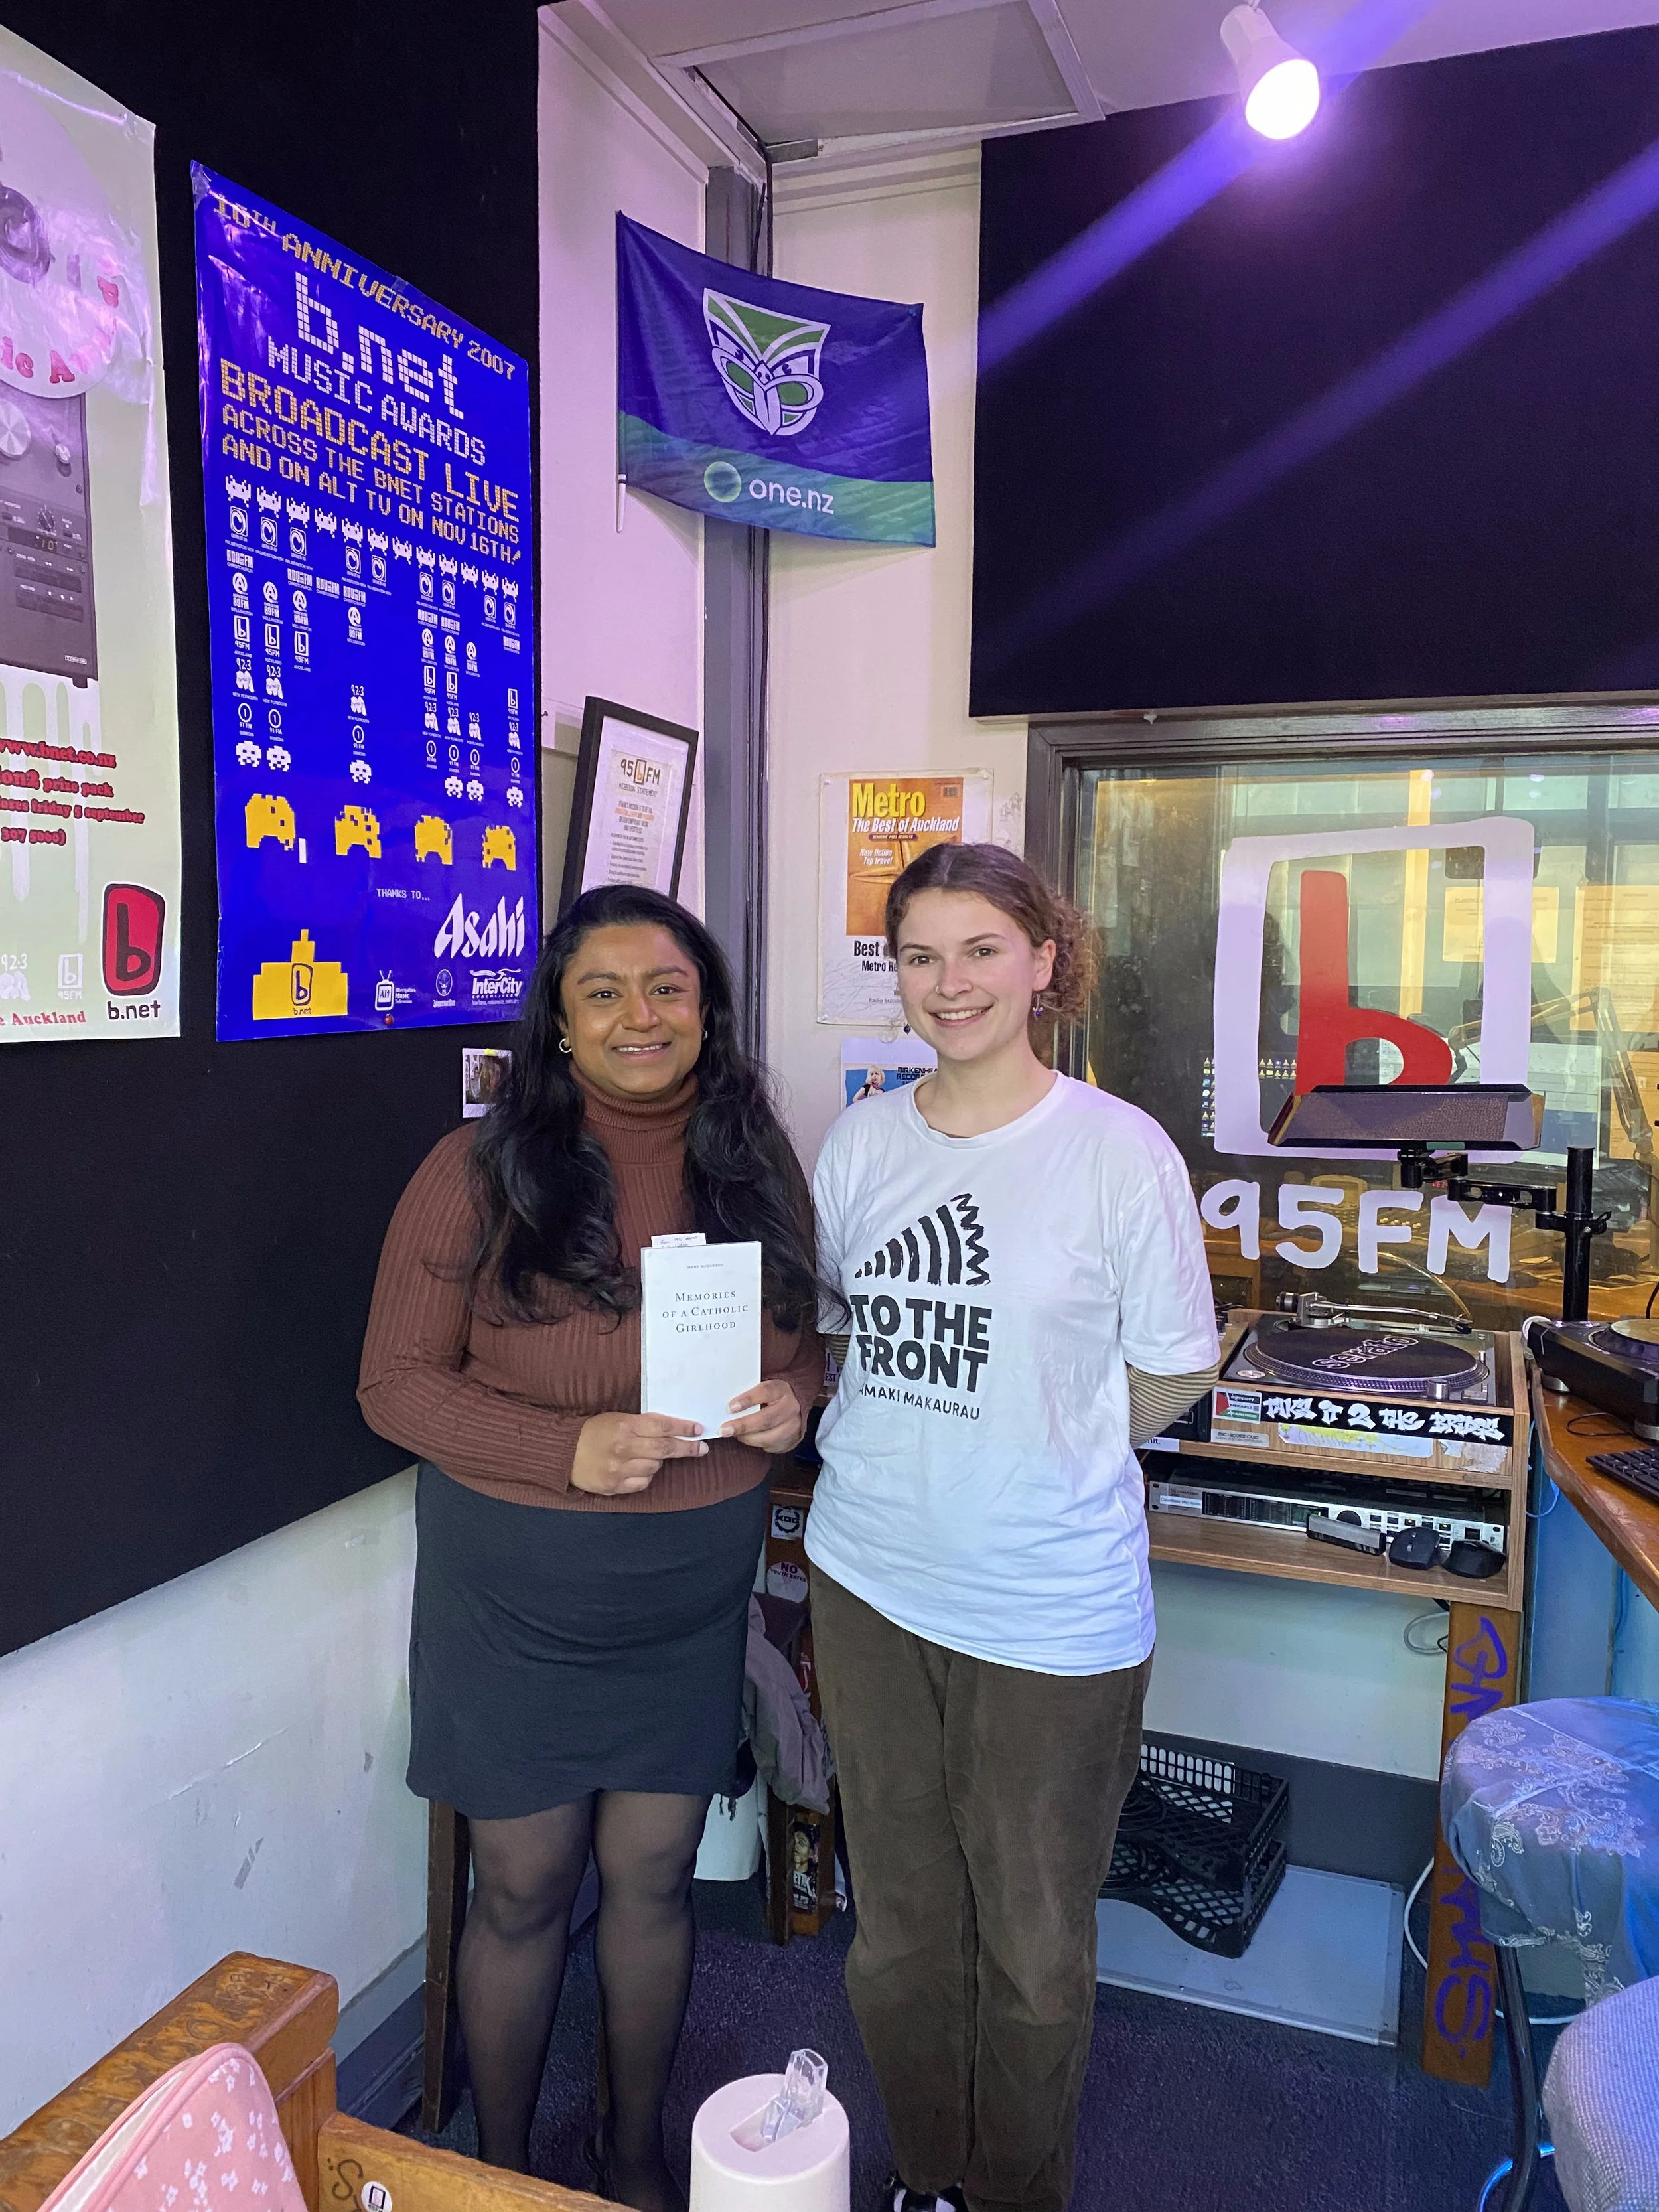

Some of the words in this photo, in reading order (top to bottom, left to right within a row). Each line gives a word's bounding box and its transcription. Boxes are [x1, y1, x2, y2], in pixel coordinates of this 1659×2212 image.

[282, 233, 463, 349] ANNIVERSARY
[467, 339, 515, 380] 2007
[295, 271, 464, 419] b.net
[268, 335, 372, 413] MUSIC
[381, 394, 485, 465] AWARDS
[221, 358, 429, 480] BROADCAST
[445, 463, 519, 522] LIVE
[222, 404, 317, 462] ACROSS
[326, 447, 364, 481] THE
[374, 467, 422, 504] BNET
[431, 492, 519, 544] STATIONS
[222, 434, 271, 471] AND
[279, 456, 309, 486] ON
[319, 471, 357, 502] ALT
[366, 489, 390, 516] TV
[399, 503, 423, 530] ON
[432, 516, 465, 544] NOV
[470, 532, 521, 565] 16TH!
[749, 478, 834, 514] one.nz
[235, 640, 250, 650] 95FM
[265, 648, 280, 658] 95FM
[295, 655, 309, 664] 95FM
[31, 798, 72, 818] friday
[84, 807, 145, 824] september
[853, 783, 925, 818] Metro
[853, 818, 870, 832] The
[872, 817, 897, 832] Best
[899, 817, 912, 833] of
[910, 817, 960, 832] Auckland
[376, 889, 407, 899] THANKS
[434, 893, 525, 958] Asahi
[854, 941, 879, 956] Best
[862, 960, 887, 972] Metro
[472, 976, 523, 997] InterCity
[12, 1011, 86, 1026] Auckland
[107, 1000, 161, 1020] b.net
[1200, 1179, 1512, 1283] 95FM
[676, 1291, 736, 1302] MEMORIES
[691, 1305, 749, 1317] CATHOLIC
[849, 1295, 901, 1336] TO
[905, 1298, 992, 1350] THE
[676, 1321, 736, 1333] GIRLHOOD
[856, 1334, 989, 1392] FRONT
[1312, 1336, 1419, 1369] serato
[861, 1384, 900, 1402] MAKI
[904, 1392, 980, 1420] MAKAURAU
[780, 1562, 798, 1574] NO
